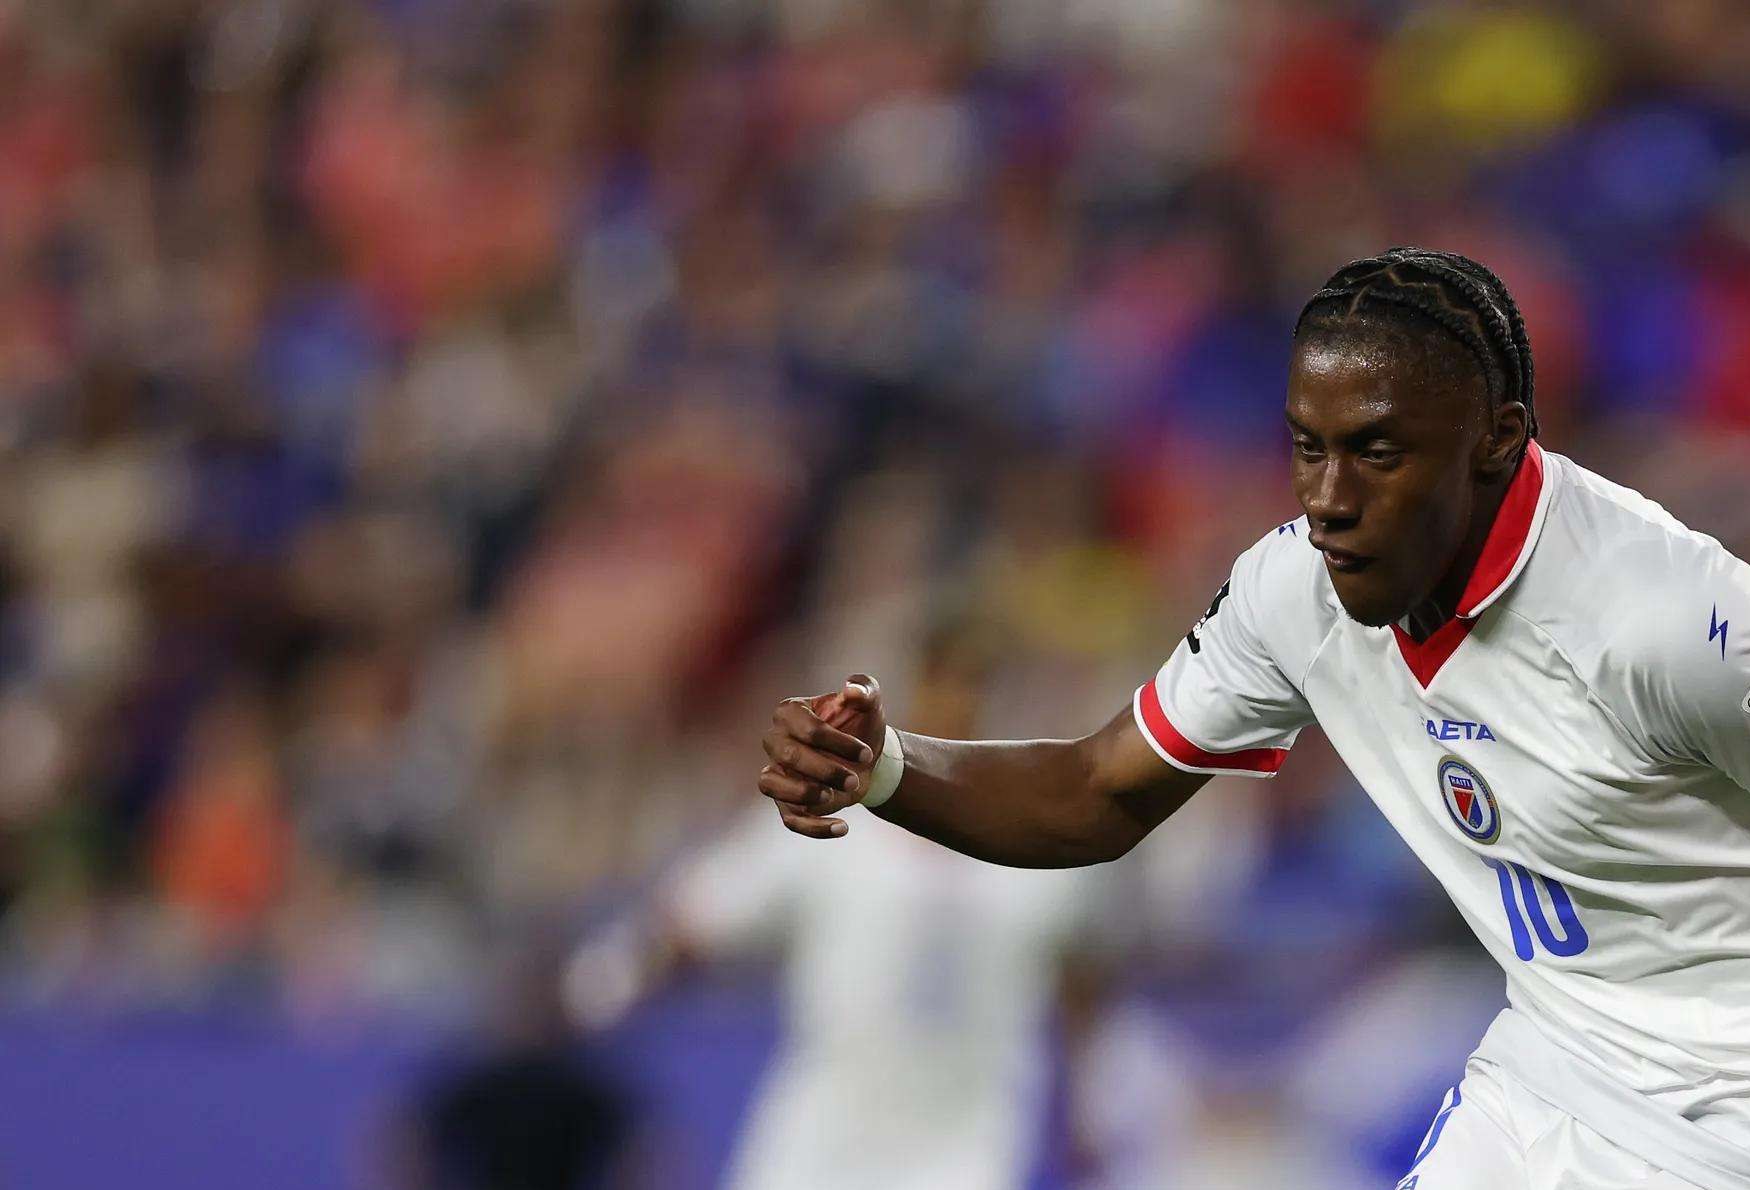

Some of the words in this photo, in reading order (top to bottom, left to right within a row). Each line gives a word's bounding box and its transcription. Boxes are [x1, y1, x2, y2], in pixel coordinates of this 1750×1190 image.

[1420, 716, 1497, 742] AETA
[1450, 776, 1472, 788] HAITI
[1480, 854, 1589, 962] 10
